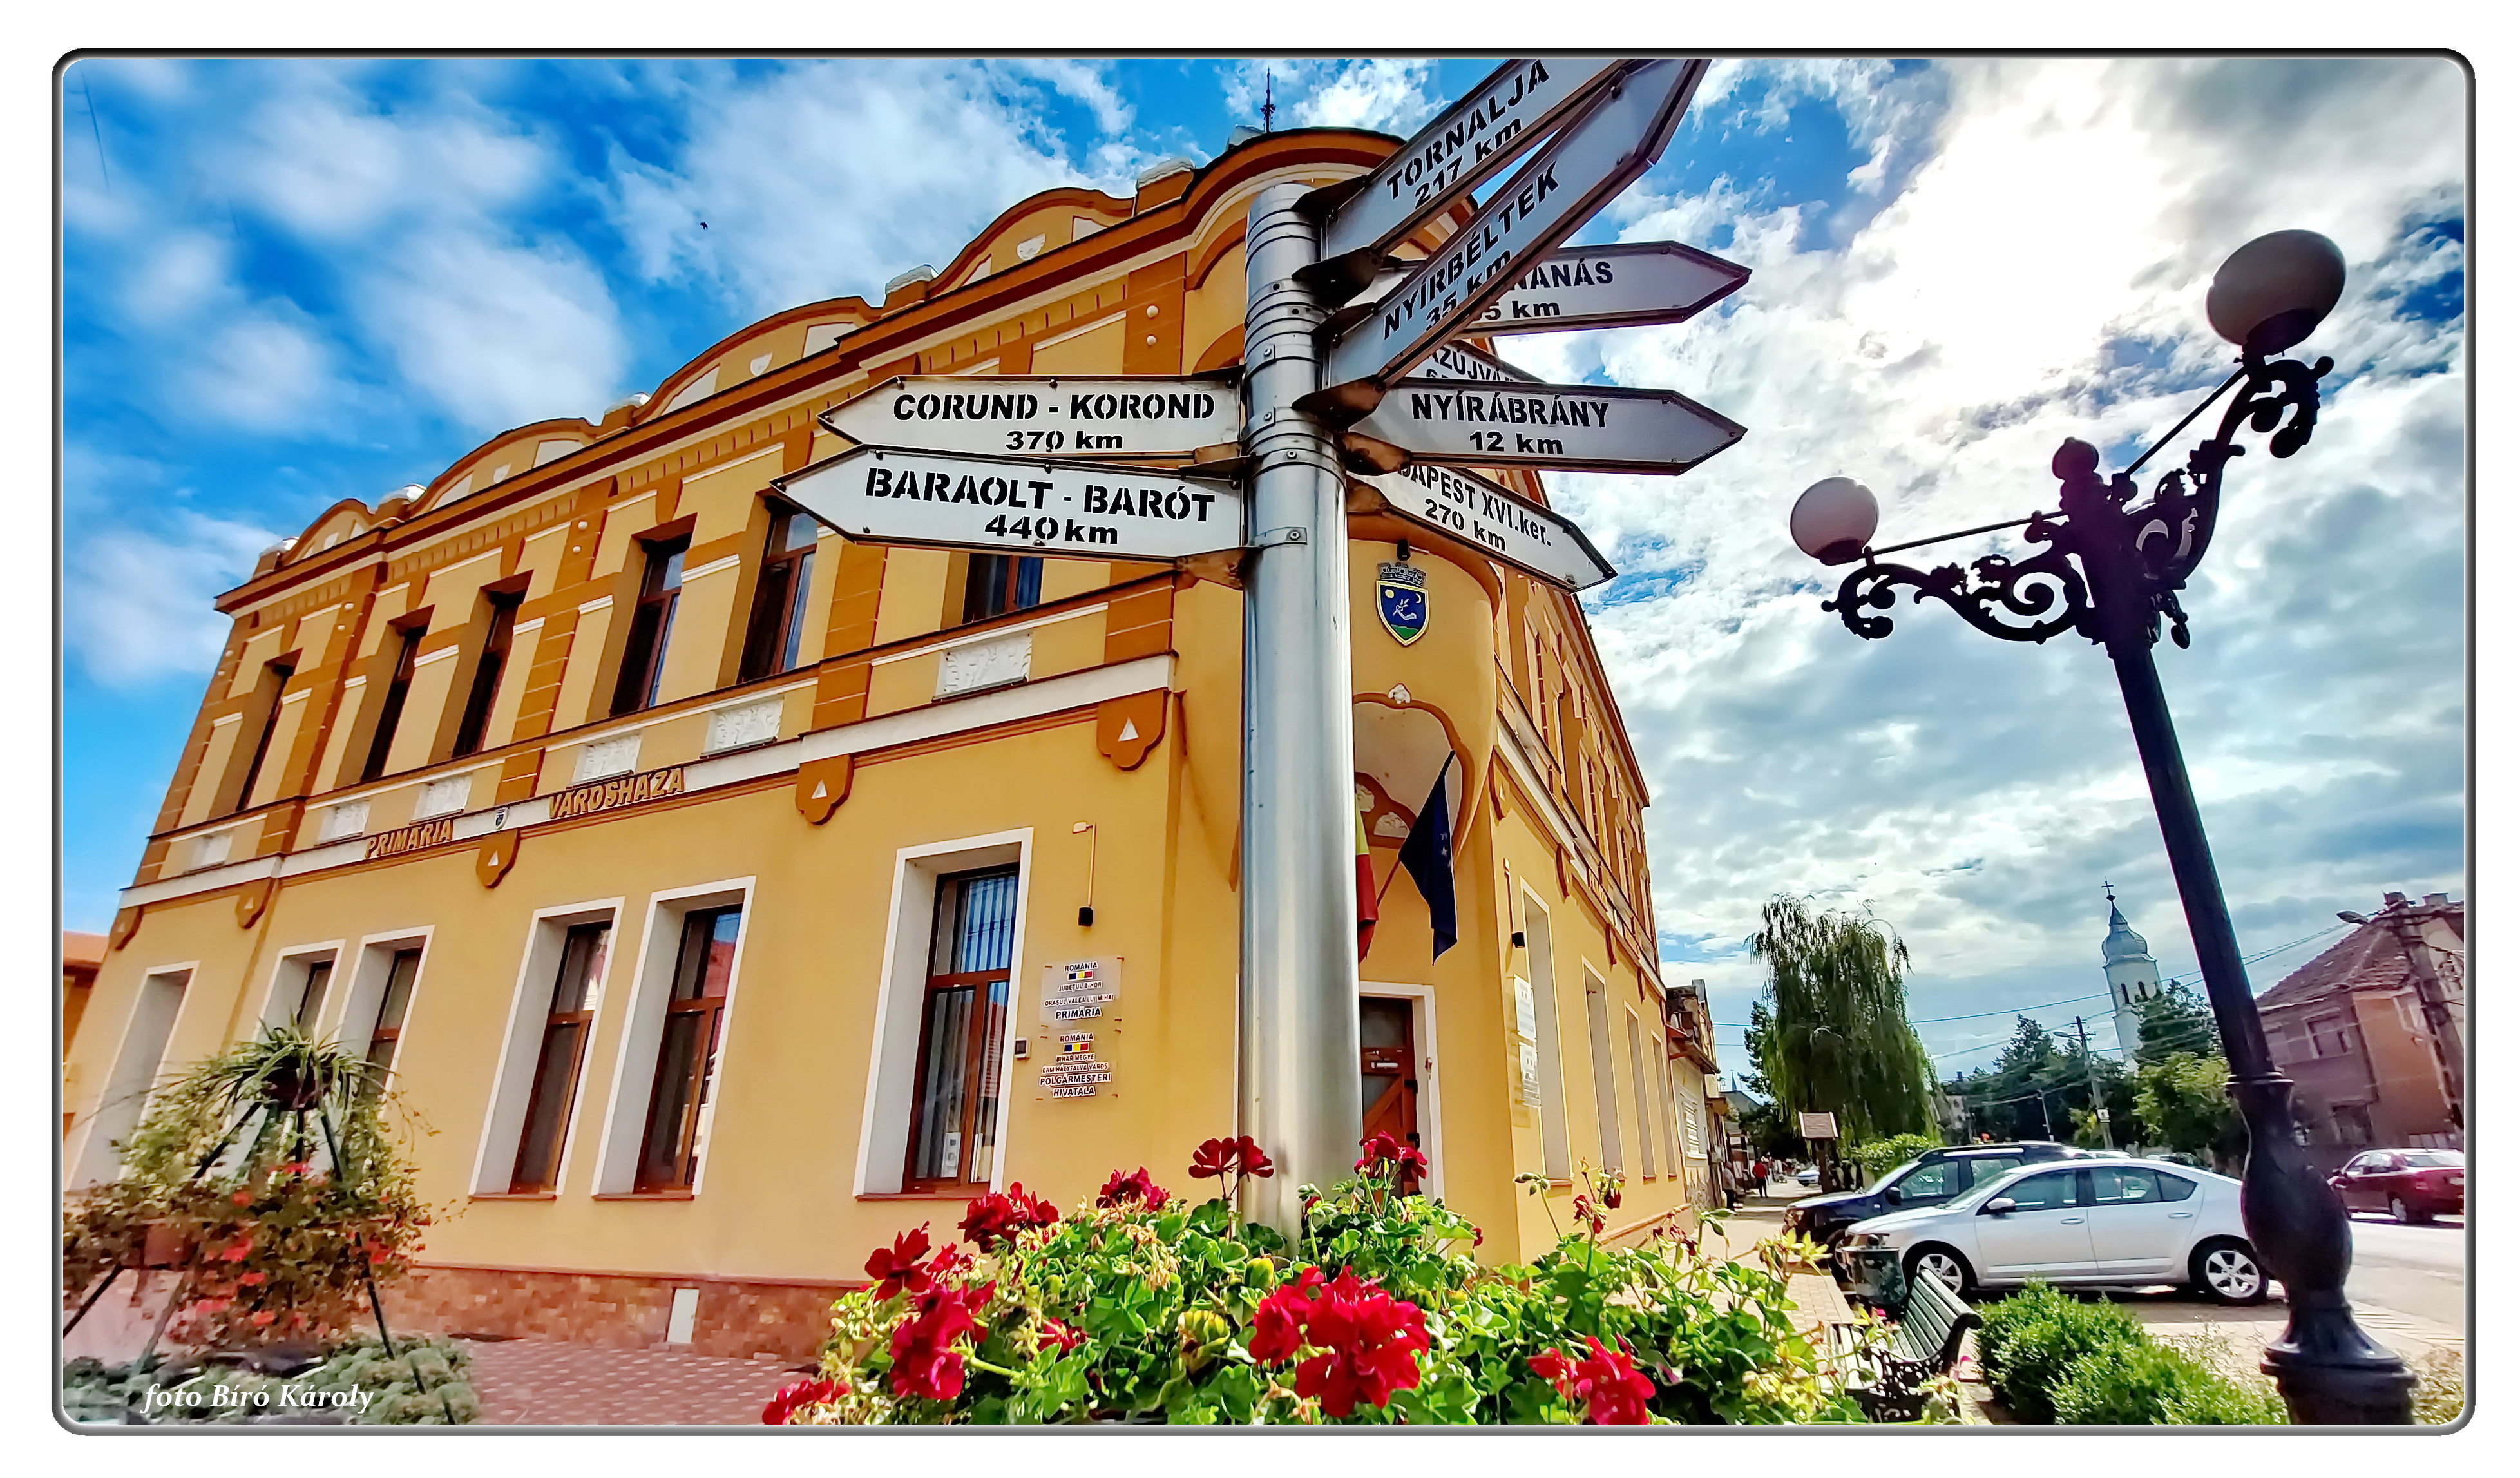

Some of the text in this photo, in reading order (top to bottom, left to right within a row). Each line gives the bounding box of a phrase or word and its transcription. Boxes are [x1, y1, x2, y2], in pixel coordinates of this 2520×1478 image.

[1386, 59, 1549, 200] TORNALJA
[1415, 117, 1522, 209] 217 km
[1384, 160, 1559, 340] NYÍRBÉLTEK
[1426, 249, 1511, 332] 35 km
[1511, 300, 1561, 318] km
[893, 394, 1038, 421] CORUND
[1069, 394, 1215, 420] KOROND
[1411, 390, 1609, 428] NYÍRÁBRÁNY
[1005, 430, 1123, 450] 370 km
[1469, 430, 1565, 455] 12 km
[865, 467, 1054, 510] BARAOLT
[1083, 485, 1216, 522] BARÓT
[984, 514, 1118, 545] 440 km
[1424, 497, 1506, 552] 270 km
[1040, 1073, 1111, 1086] POLGÁRMESTERI
[1053, 1086, 1095, 1097] HIVATALA
